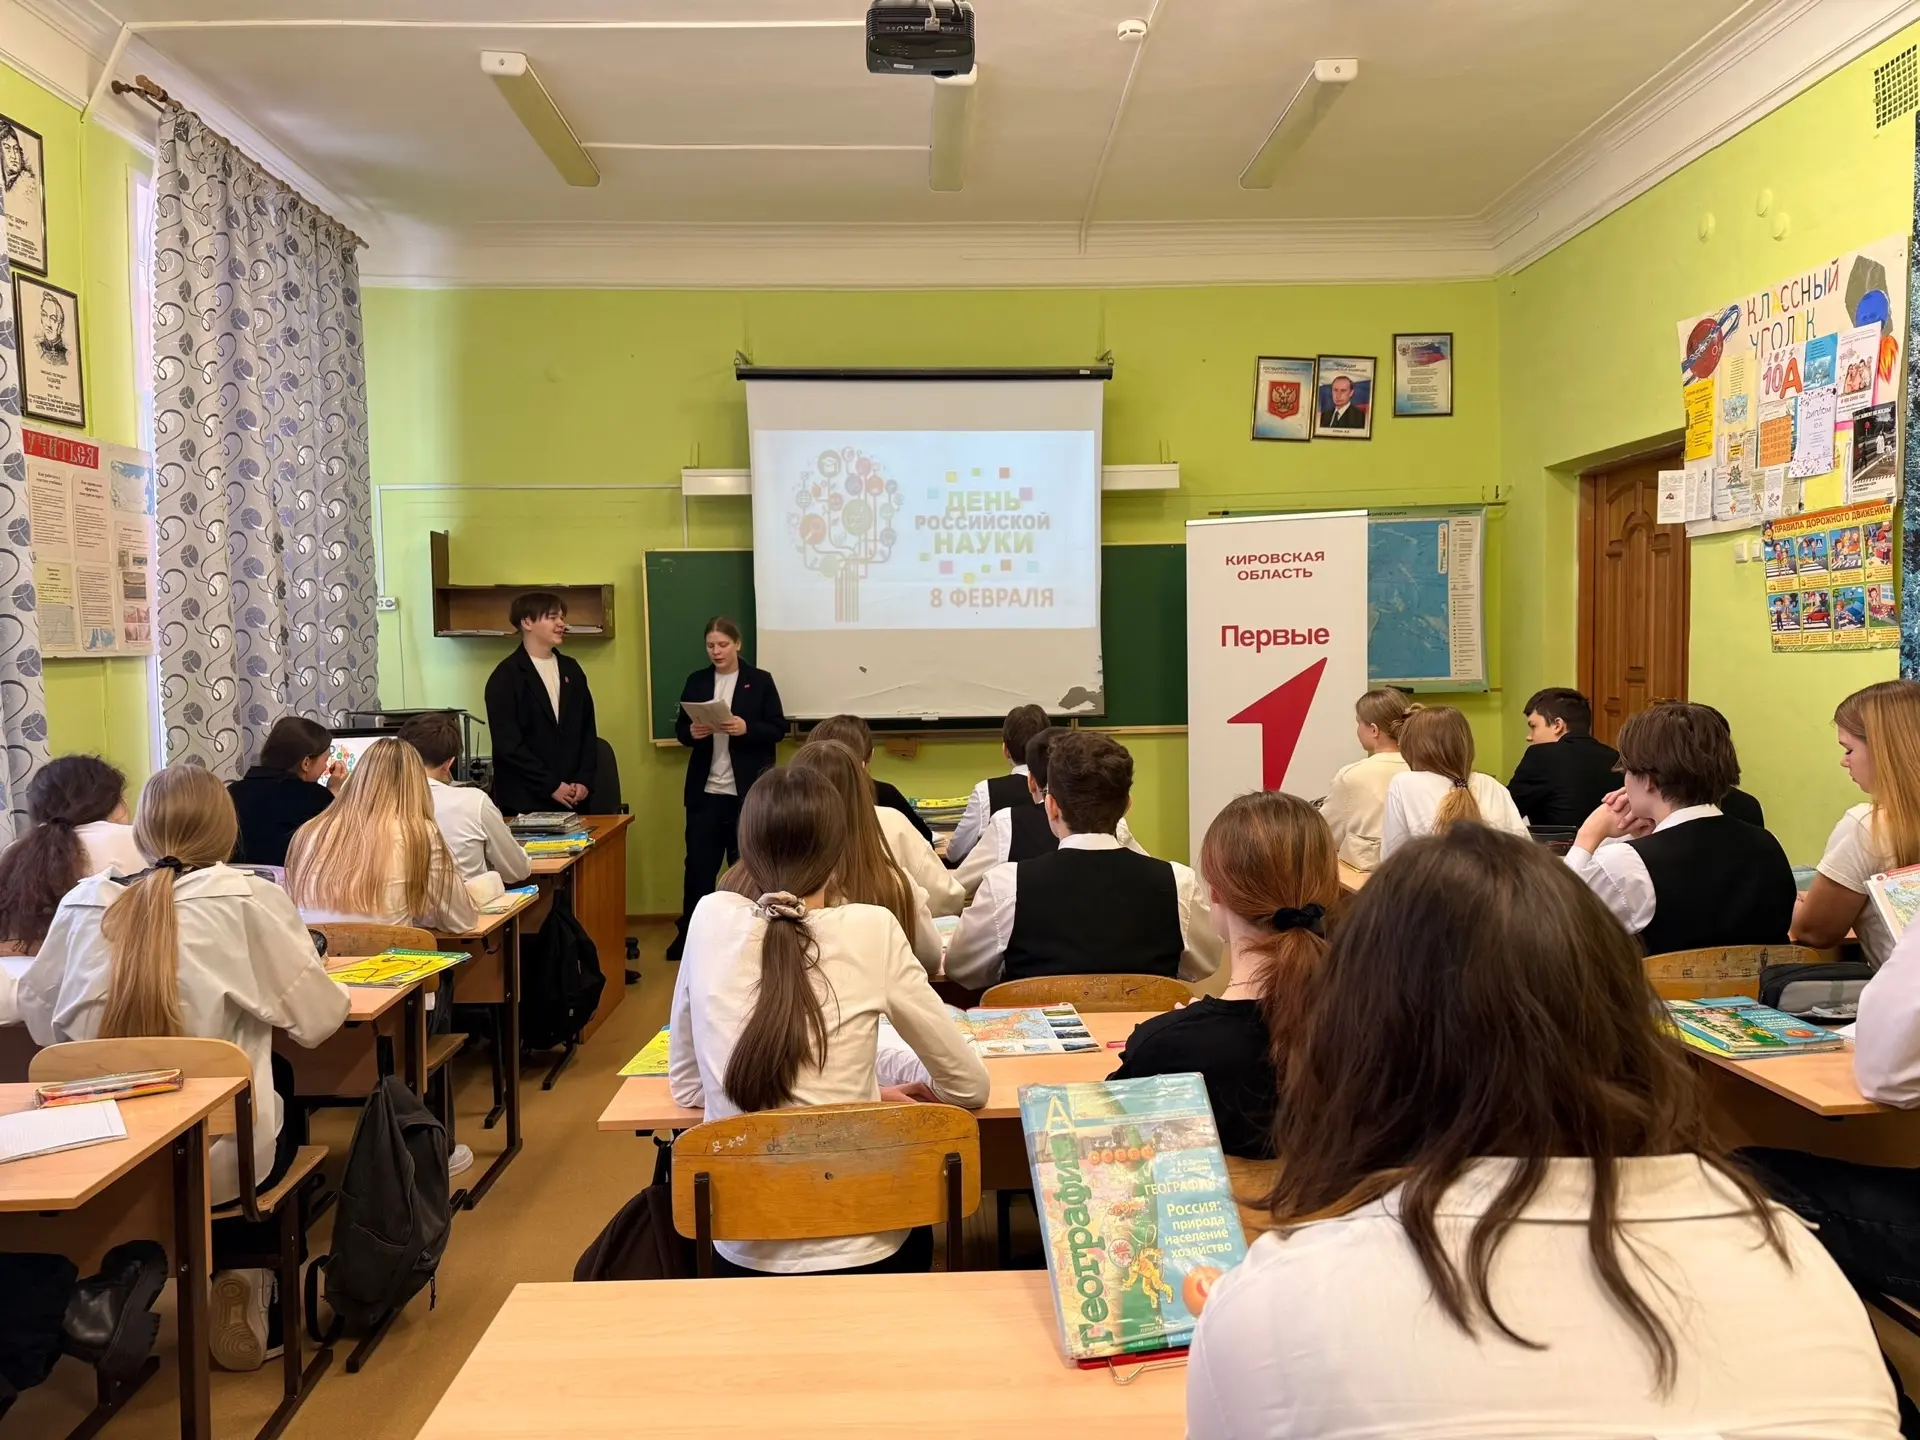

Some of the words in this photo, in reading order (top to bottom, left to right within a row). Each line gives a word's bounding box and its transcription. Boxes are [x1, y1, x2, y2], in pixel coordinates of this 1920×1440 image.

[1746, 257, 1840, 326] КЛАССНЫЙ
[1749, 307, 1817, 360] УГОЛОК
[945, 491, 1022, 518] ДЕНЬ
[915, 512, 1051, 531] РОССИЙСКОЙ
[1774, 520, 1805, 534] ПРАВИЛА
[1806, 513, 1850, 529] ДОРОЖНОГО
[1851, 504, 1892, 522] ДВИЖЕНИЯ
[934, 532, 1034, 554] НАУКИ
[1225, 551, 1325, 566] КИРОВСКАЯ
[1237, 568, 1313, 581] ОБЛАСТЬ
[930, 588, 942, 608] 8
[949, 587, 1054, 608] ФЕВРАЛЯ
[1221, 625, 1330, 653] Первые
[1144, 1178, 1216, 1196] ГЕОГРАФИЯ
[1166, 1200, 1222, 1217] Россия:
[1172, 1215, 1225, 1232] природа
[1164, 1228, 1229, 1245] население
[1171, 1242, 1232, 1258] хозяйство
